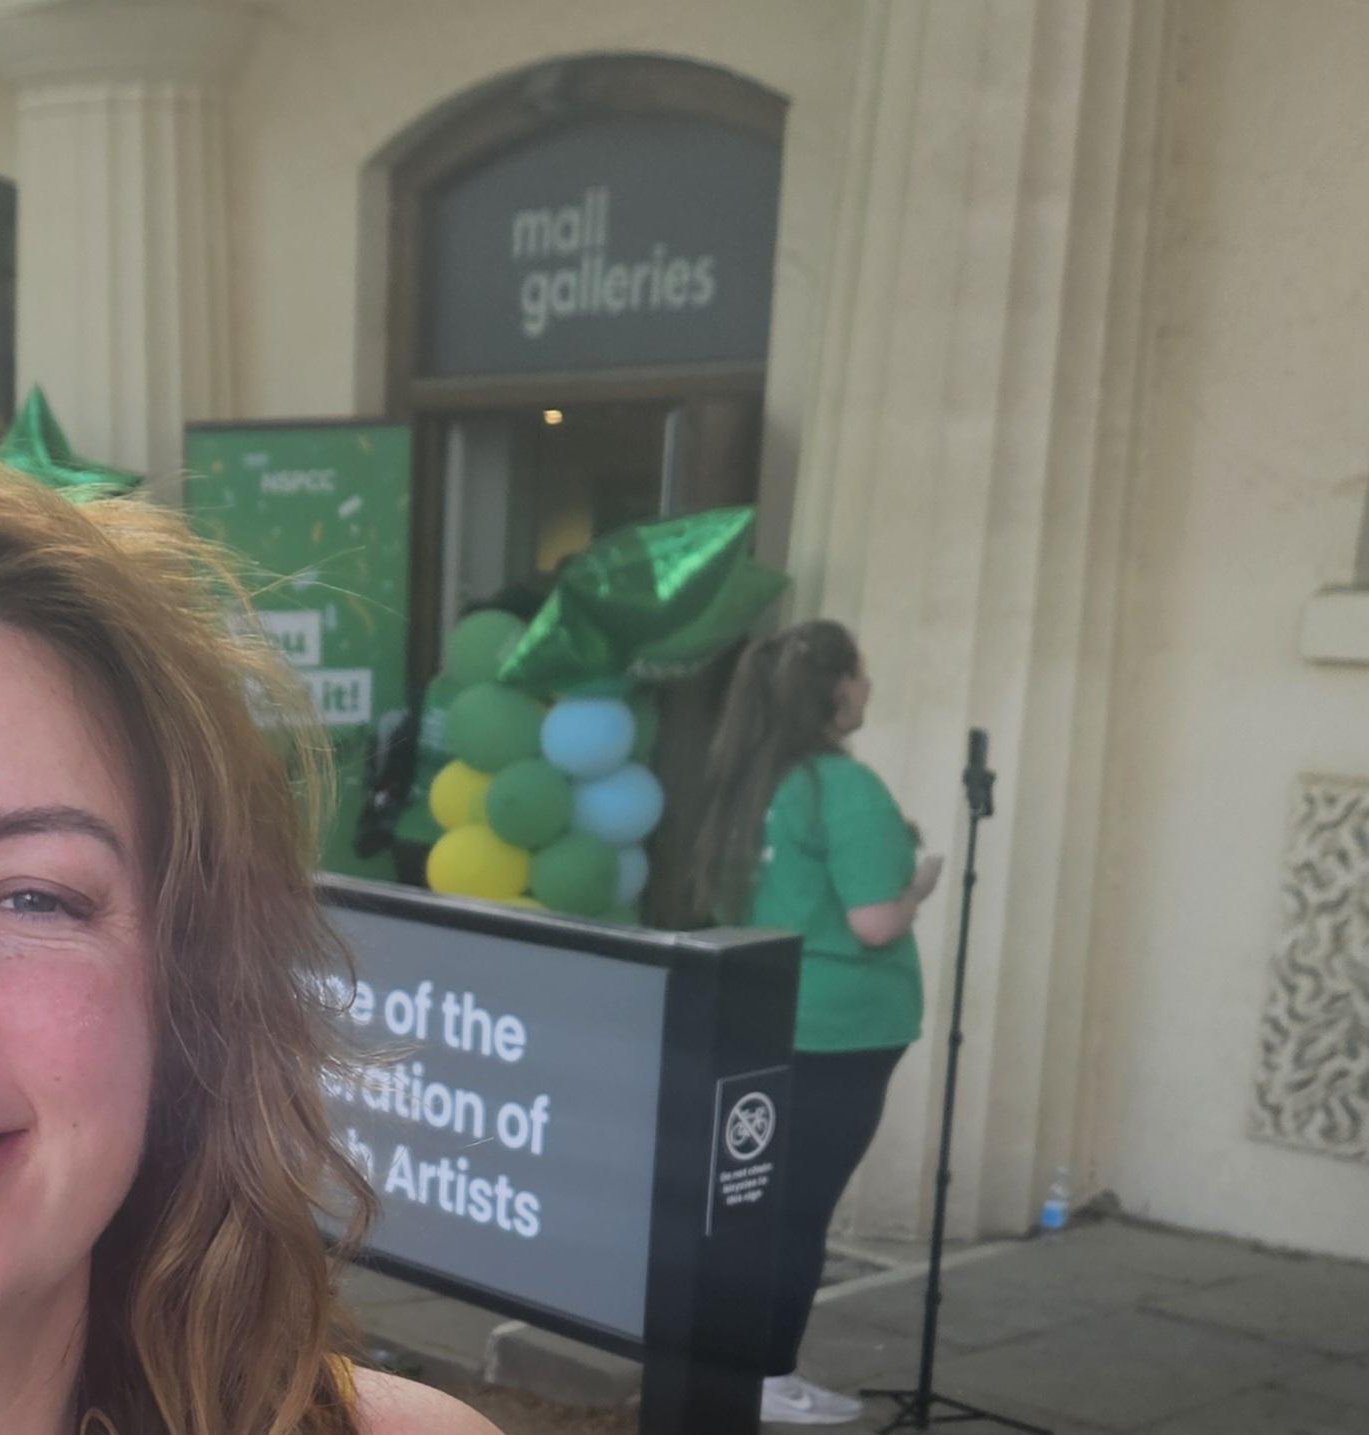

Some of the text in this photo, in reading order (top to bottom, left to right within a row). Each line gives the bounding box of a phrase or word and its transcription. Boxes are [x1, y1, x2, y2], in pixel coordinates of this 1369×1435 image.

[512, 185, 608, 258] mall
[522, 242, 714, 338] galleries
[260, 469, 334, 492] NSPCC
[385, 980, 434, 1040] of
[442, 991, 527, 1063] the
[497, 1093, 550, 1155] of
[384, 1144, 541, 1238] Artists
